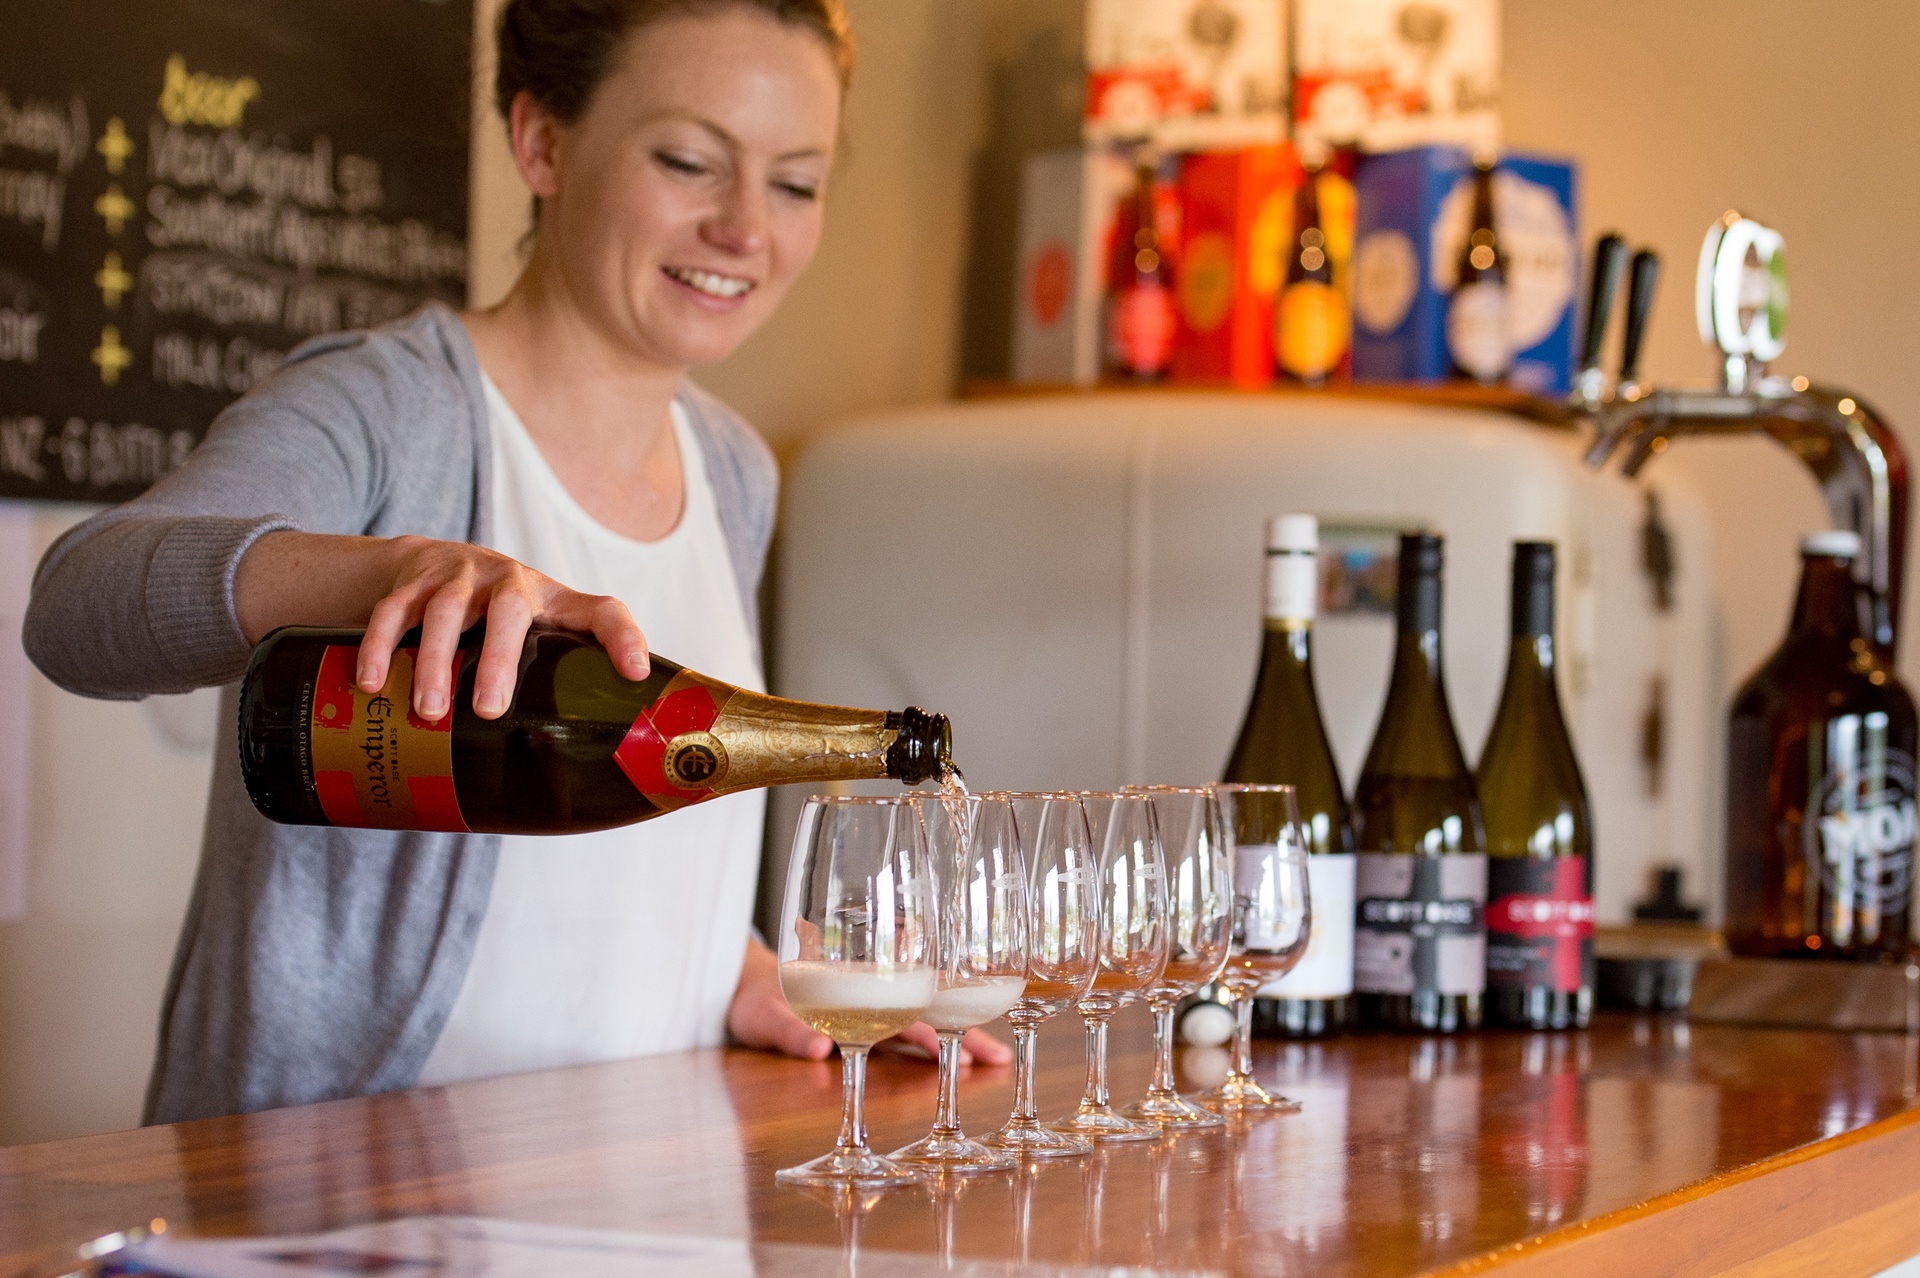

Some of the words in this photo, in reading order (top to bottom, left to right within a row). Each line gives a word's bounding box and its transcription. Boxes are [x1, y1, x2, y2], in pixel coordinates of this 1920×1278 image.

[160, 53, 259, 126] beer
[217, 133, 334, 212] Original
[148, 188, 279, 257] Southern
[299, 682, 312, 729] CENTRAL
[299, 731, 308, 767] OTAGO
[359, 693, 394, 808] Emperor
[390, 727, 398, 757] SCOTT
[674, 734, 715, 748] EMPEROR
[302, 769, 312, 792] BRUT
[391, 759, 400, 782] BASE
[1363, 901, 1423, 923] SCOTT
